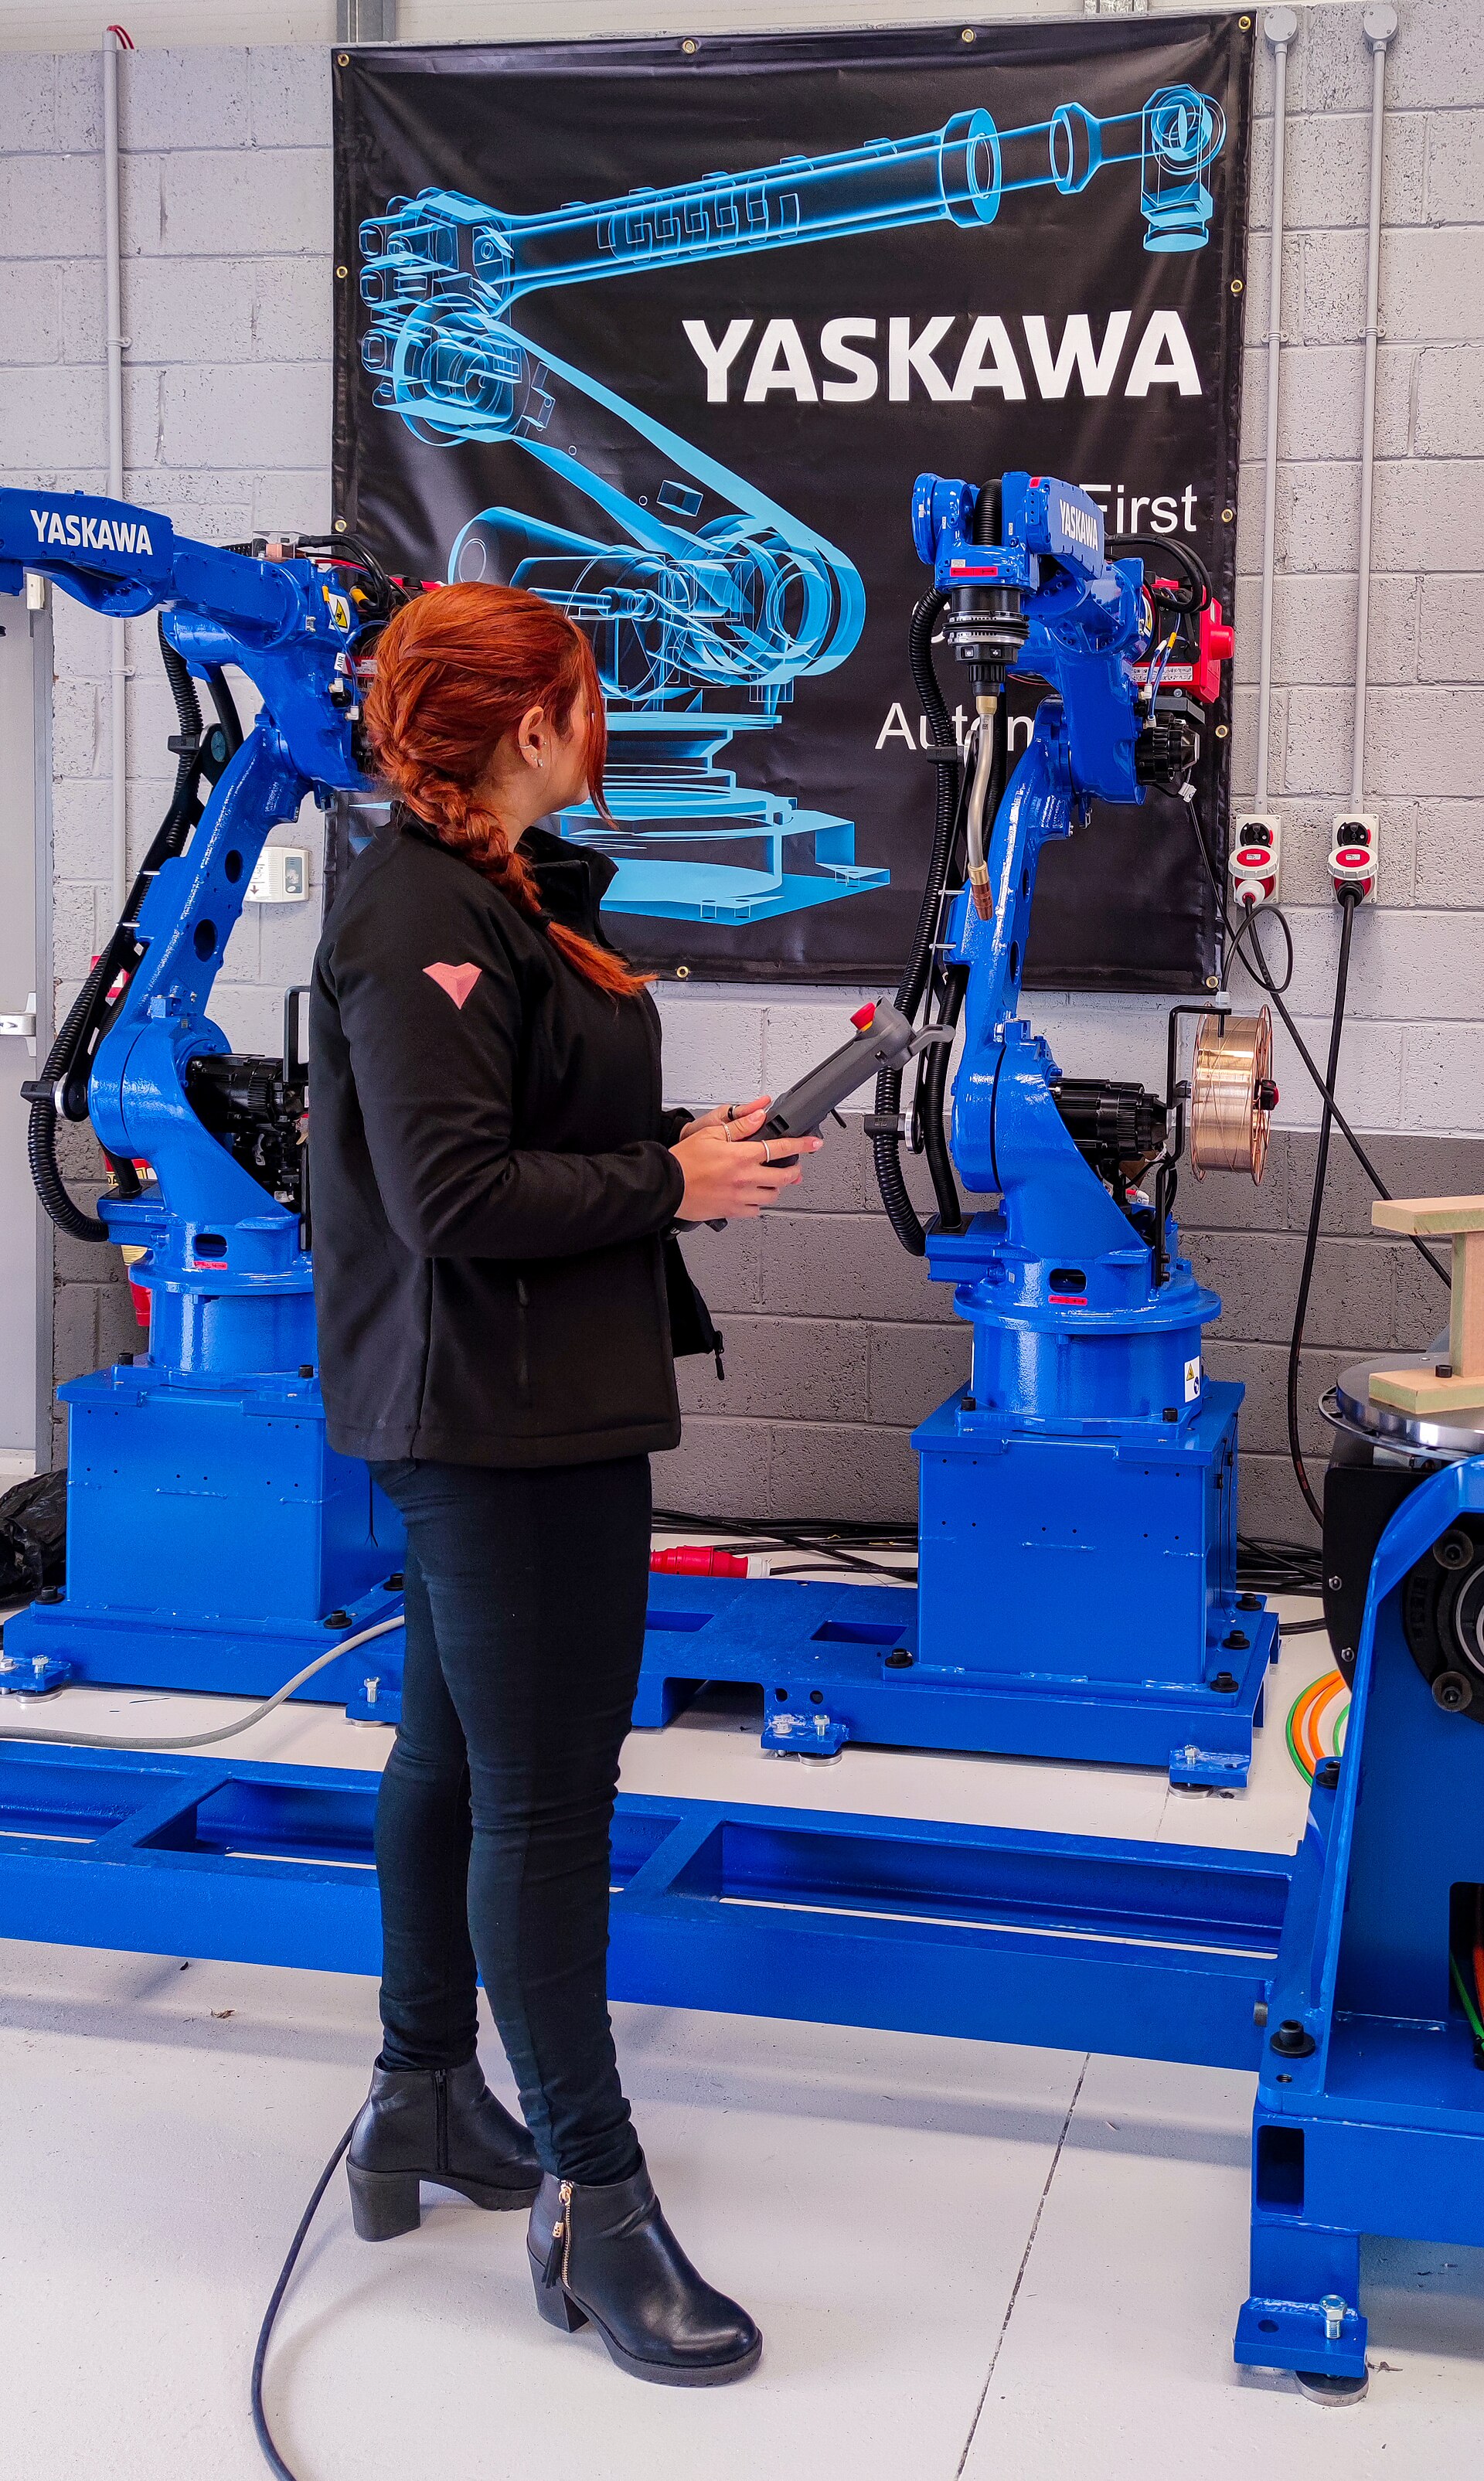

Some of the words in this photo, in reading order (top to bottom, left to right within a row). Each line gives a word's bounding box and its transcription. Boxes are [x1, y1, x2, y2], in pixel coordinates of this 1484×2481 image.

[682, 311, 1203, 403] YASKAWA
[30, 510, 153, 555] YASKAWA
[1059, 499, 1098, 551] YASKAWA
[336, 655, 345, 668] AIR
